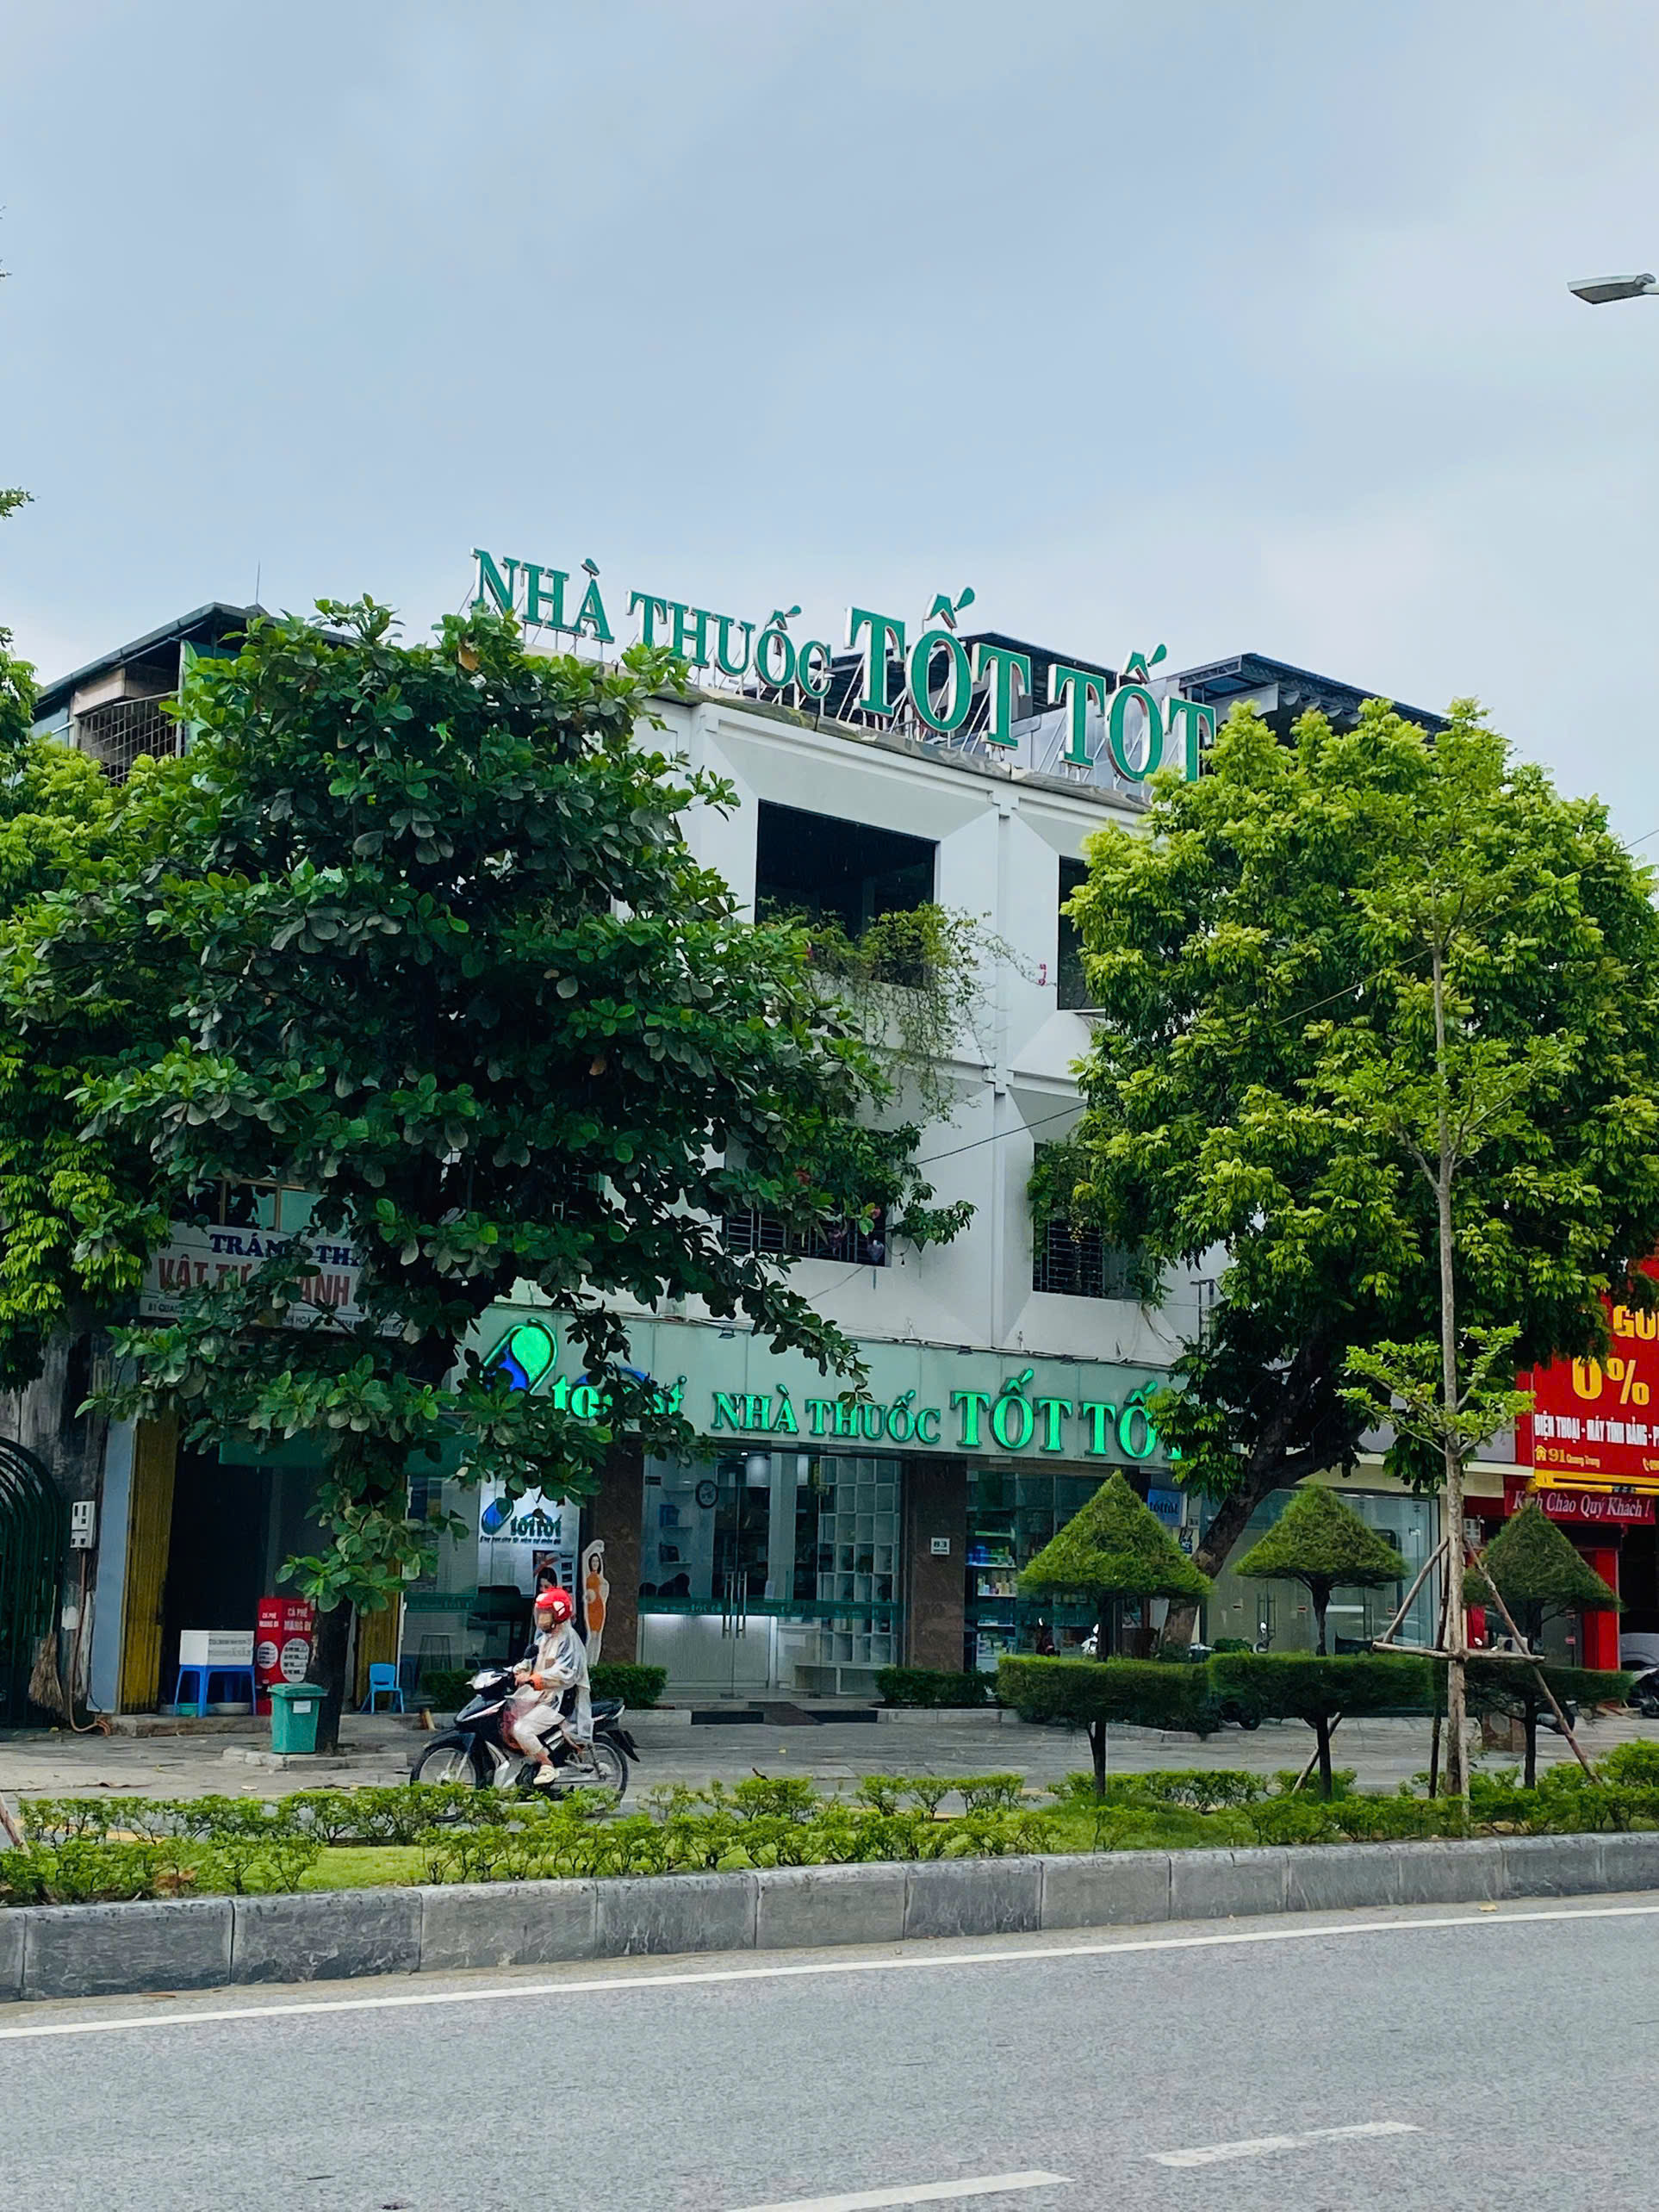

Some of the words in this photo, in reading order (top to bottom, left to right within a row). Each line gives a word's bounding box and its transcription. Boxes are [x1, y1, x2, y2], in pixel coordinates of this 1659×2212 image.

[470, 548, 615, 643] NHÀ
[625, 590, 832, 699] THUỐC
[845, 587, 1033, 749] TỐT
[1047, 643, 1216, 784] TỐT
[316, 1245, 362, 1266] TH
[711, 1383, 799, 1435] NHÀ
[805, 1389, 941, 1445] THUỐC
[950, 1368, 1073, 1451] TỐT
[1078, 1381, 1183, 1460] TỐ
[1556, 1415, 1580, 1444] THOẠI
[1587, 1415, 1605, 1442] MÁY
[1548, 1449, 1565, 1463] 91
[1546, 1492, 1576, 1513] Chào
[1580, 1494, 1606, 1519] Quý
[1606, 1497, 1643, 1517] Khách
